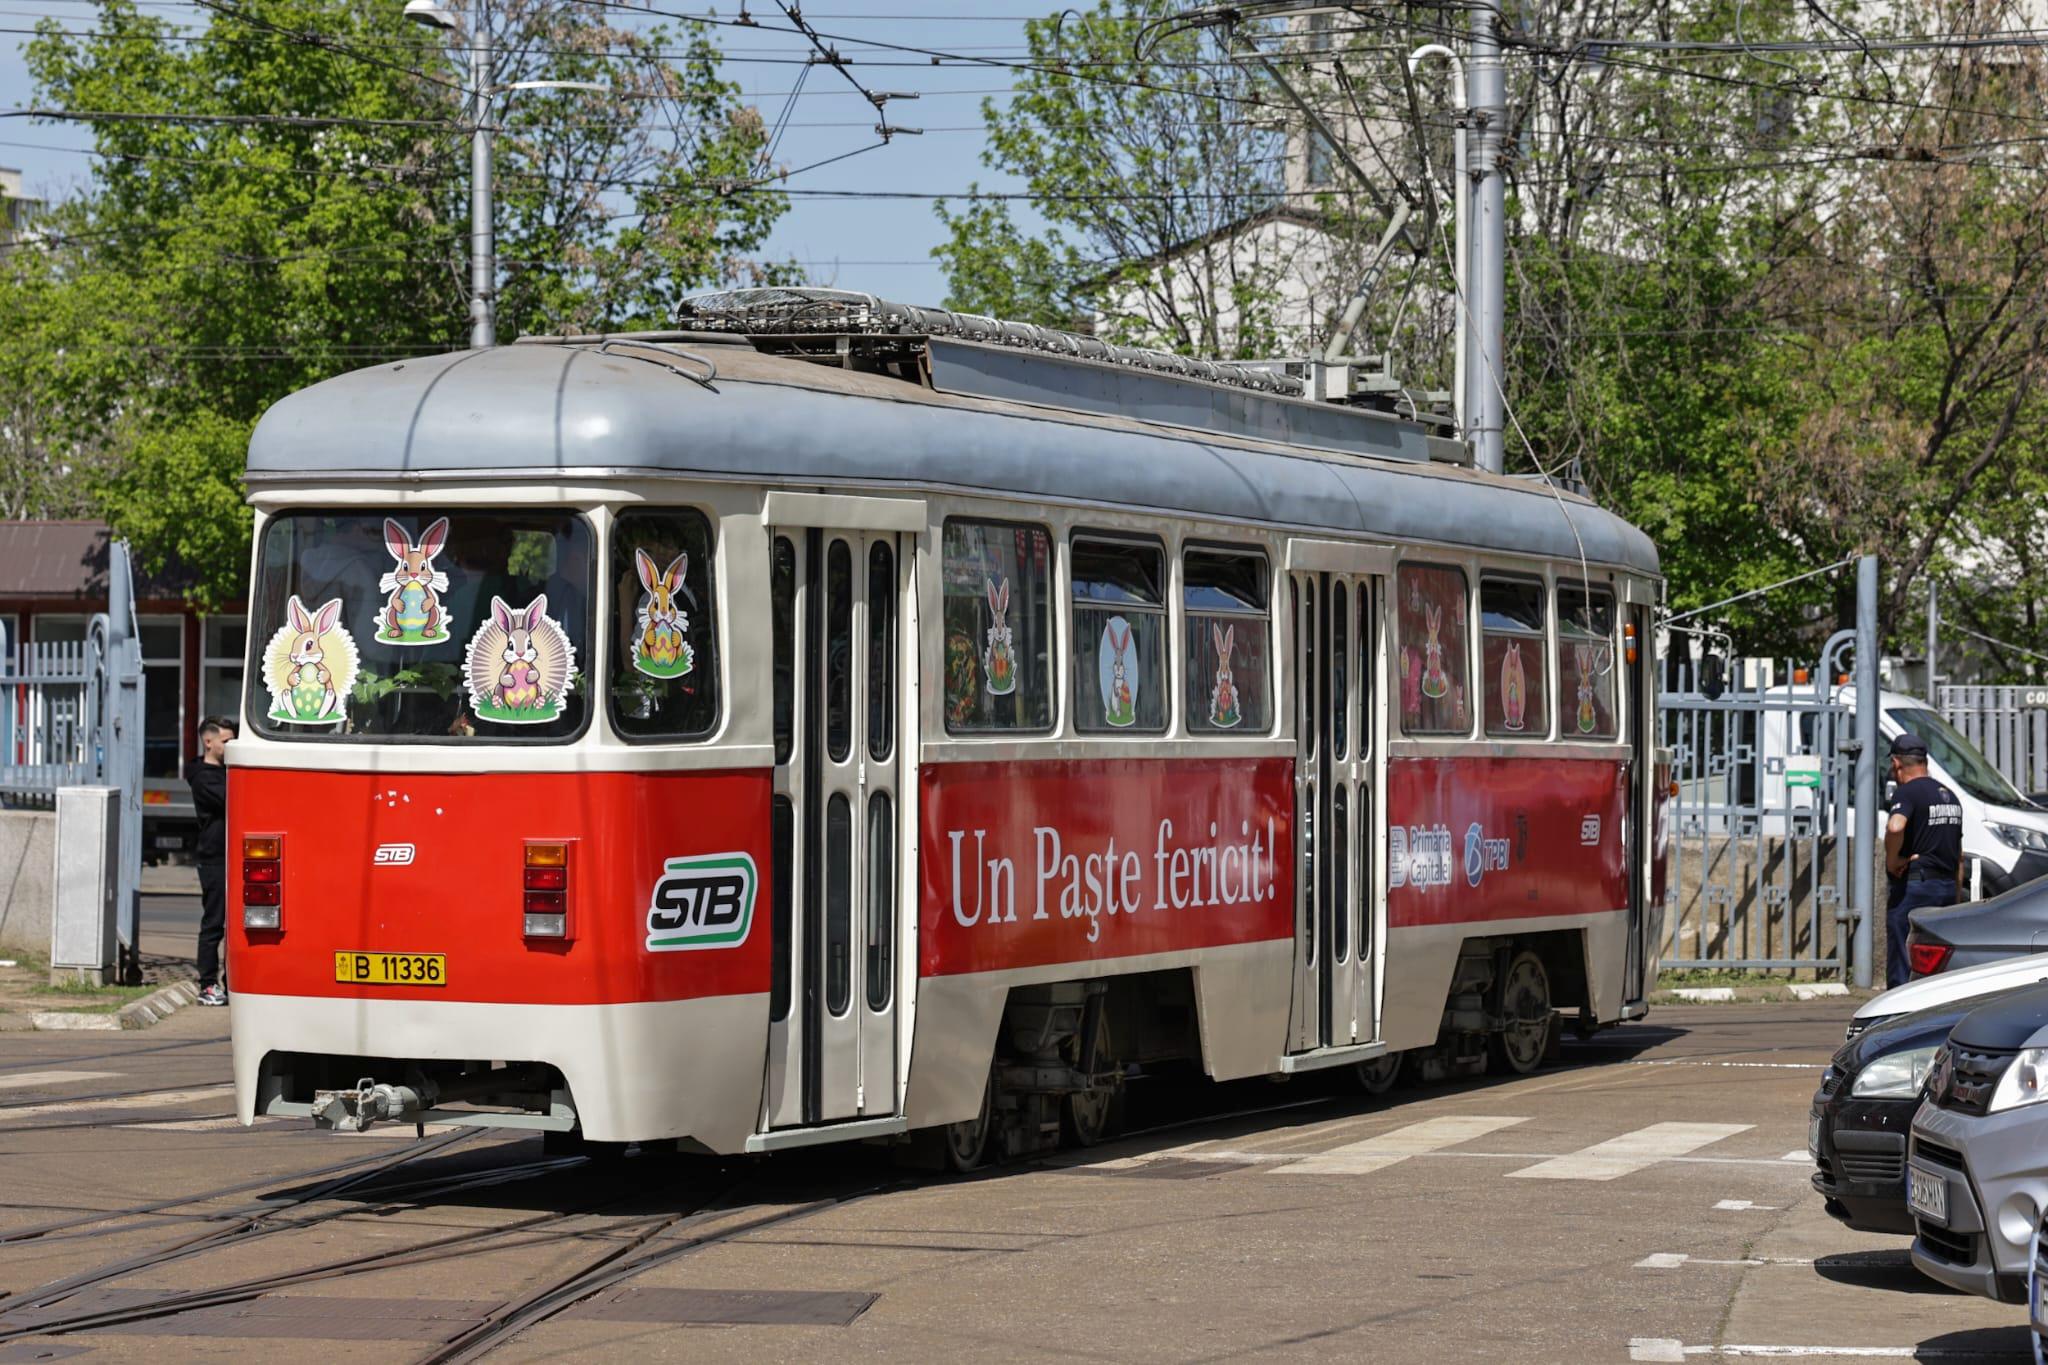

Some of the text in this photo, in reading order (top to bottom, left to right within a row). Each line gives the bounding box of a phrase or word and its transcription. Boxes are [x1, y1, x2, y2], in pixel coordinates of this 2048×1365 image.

[2026, 691, 2048, 704] CO
[1582, 820, 1598, 839] STB
[374, 847, 411, 862] STB
[1483, 840, 1509, 870] TPBI
[948, 830, 1017, 927] Un
[1153, 816, 1275, 910] fericit!
[1411, 858, 1451, 891] Capitalei
[651, 875, 744, 930] STB
[356, 956, 440, 980] B 11336
